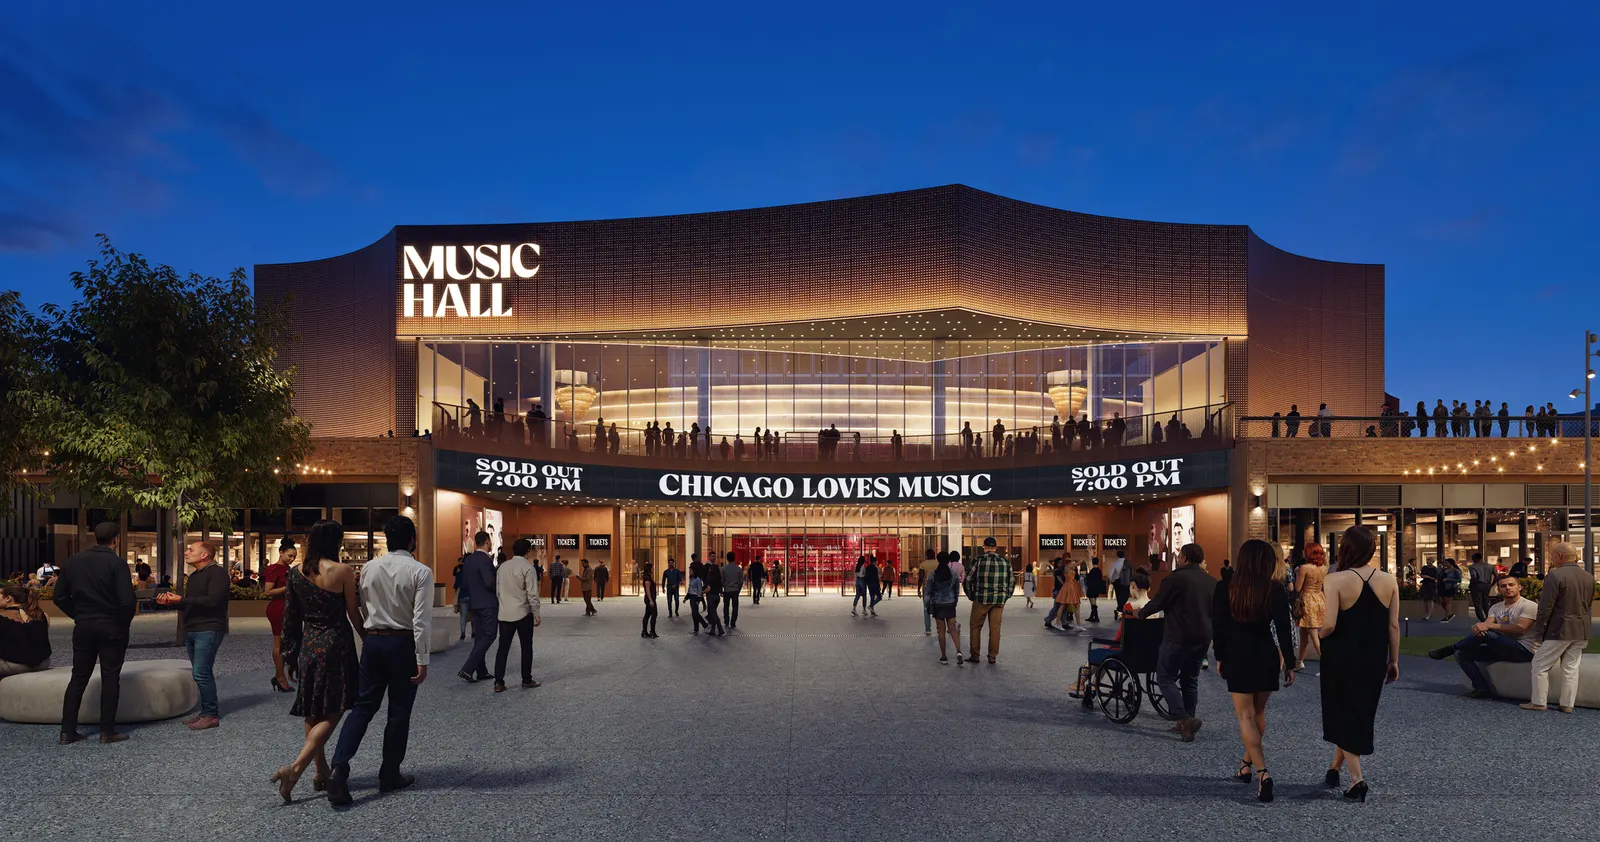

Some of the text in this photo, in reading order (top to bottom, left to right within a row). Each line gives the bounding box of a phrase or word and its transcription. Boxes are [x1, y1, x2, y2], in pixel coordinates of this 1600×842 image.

[403, 243, 541, 280] MUSIC
[403, 283, 513, 318] HALL
[475, 458, 584, 479] SOLD OUT
[1071, 458, 1184, 479] SOLD OUT
[477, 470, 582, 492] 7:00 PM
[658, 473, 992, 500] CHICAGO LOVES MUSIC
[1072, 471, 1181, 492] 7:00 PM
[557, 538, 576, 546] TICKETS
[589, 538, 609, 546] TICKETS
[1041, 538, 1064, 547] TICKETS
[1073, 538, 1096, 547] TICKETS
[1104, 538, 1127, 547] TICKETS
